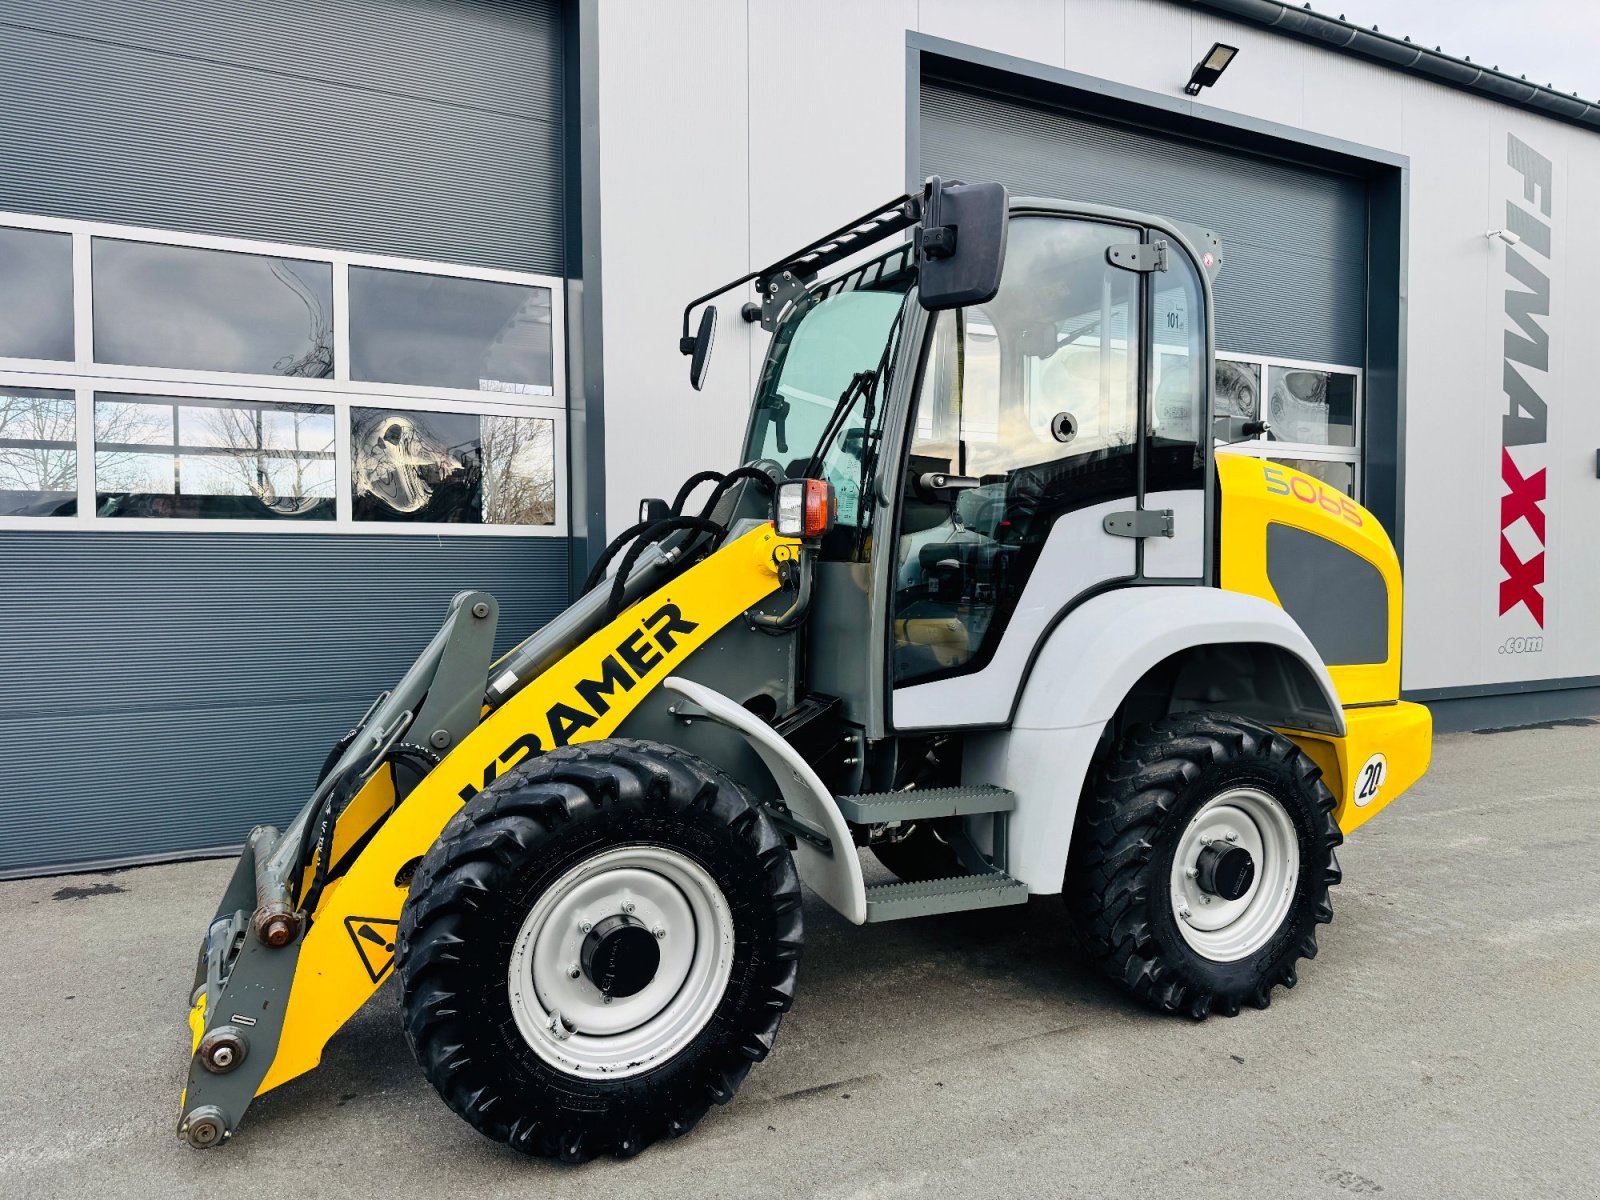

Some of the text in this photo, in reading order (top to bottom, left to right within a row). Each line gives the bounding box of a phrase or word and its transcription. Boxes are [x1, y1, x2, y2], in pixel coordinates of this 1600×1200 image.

[1166, 311, 1179, 329] 101
[1499, 132, 1552, 630] FIMAXX
[1263, 467, 1363, 528] 5065
[1497, 637, 1544, 655] .com
[1358, 761, 1383, 799] 20
